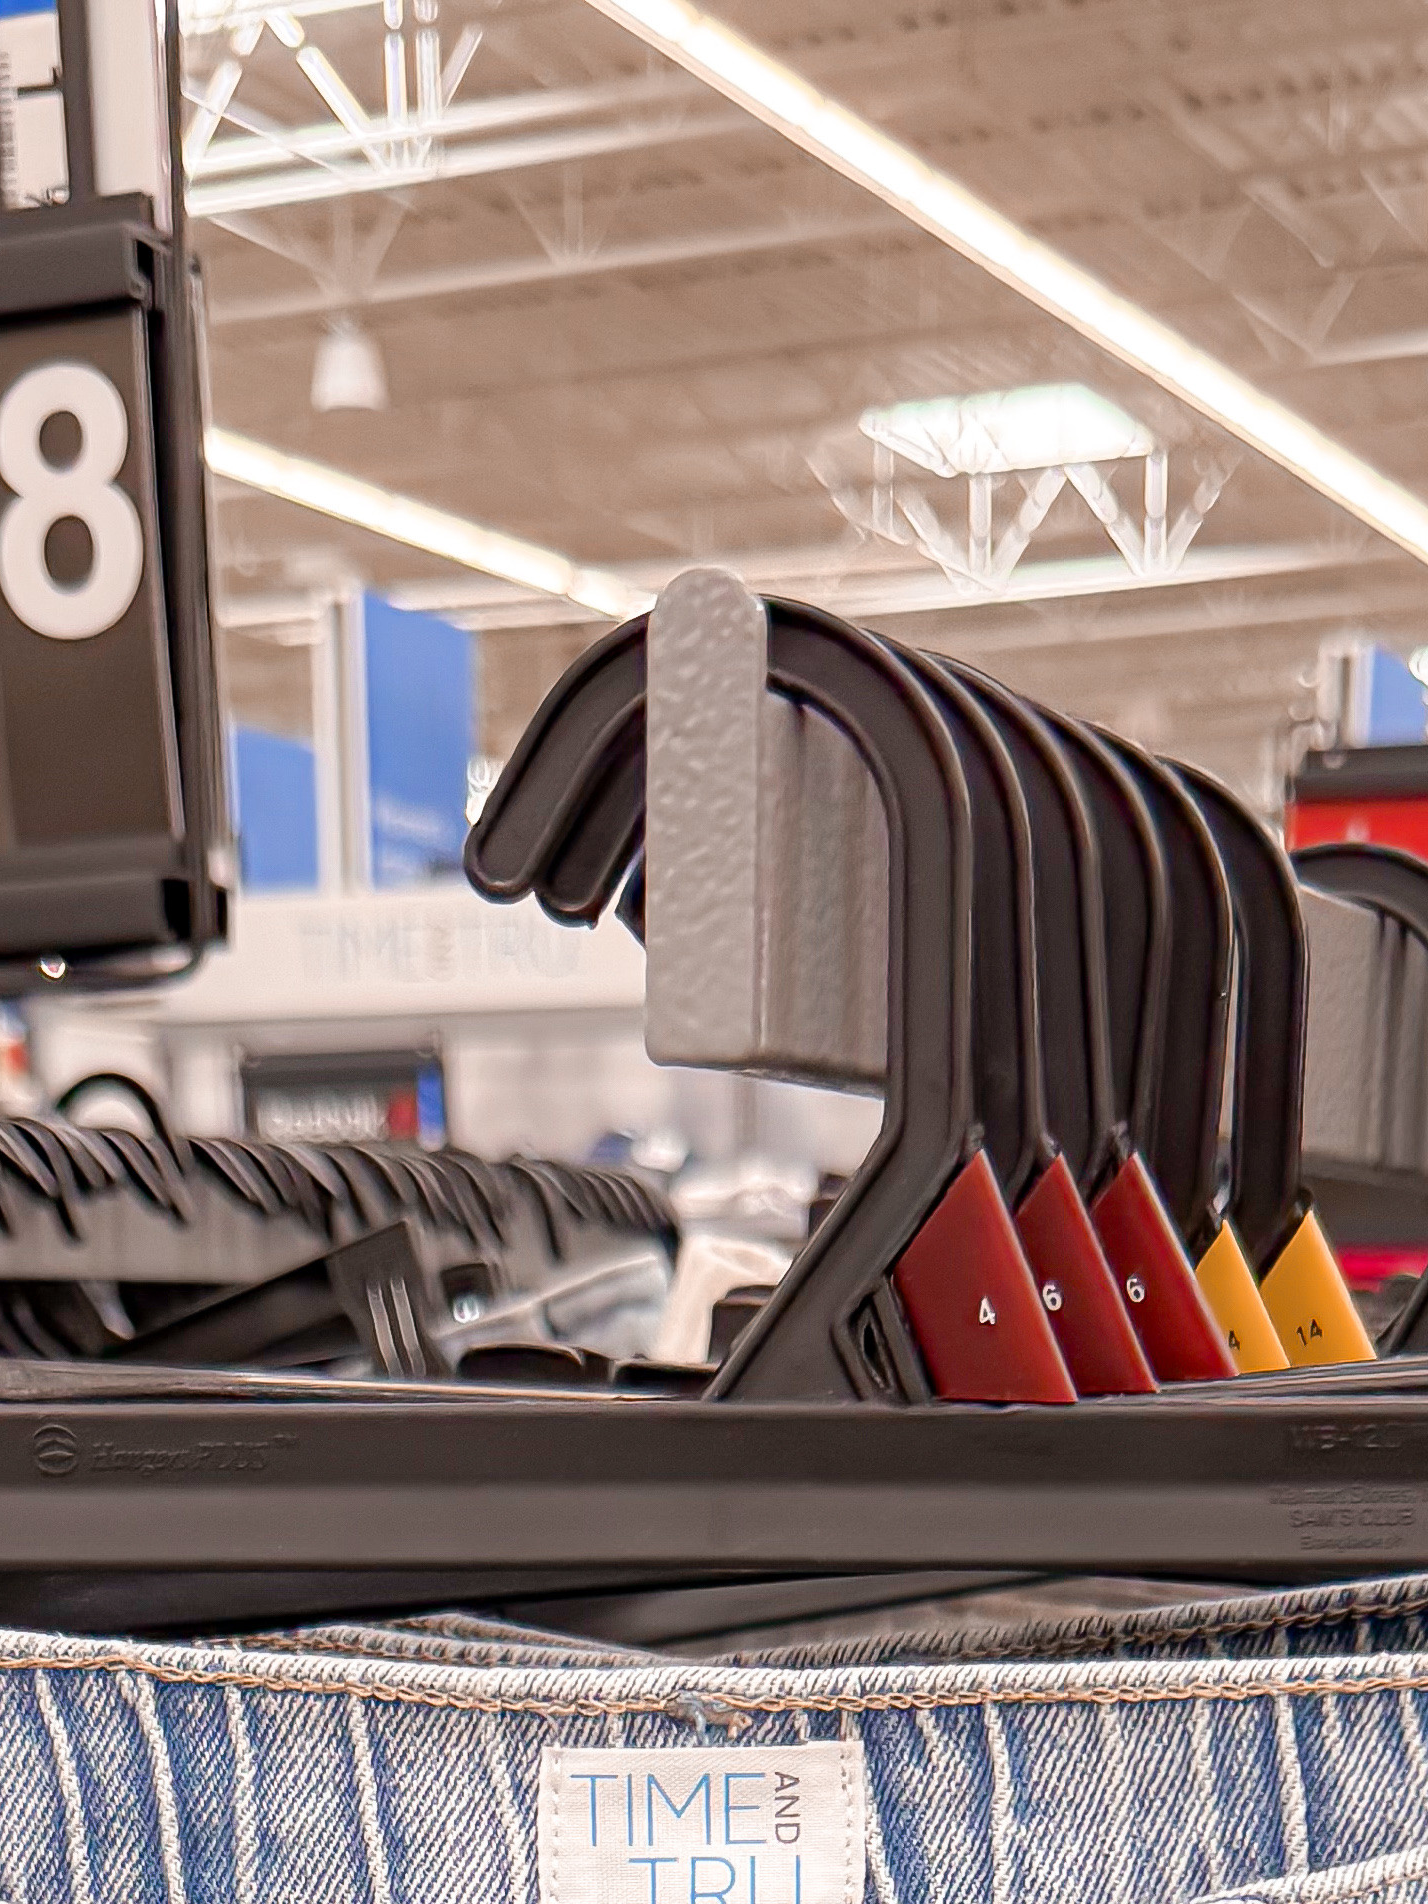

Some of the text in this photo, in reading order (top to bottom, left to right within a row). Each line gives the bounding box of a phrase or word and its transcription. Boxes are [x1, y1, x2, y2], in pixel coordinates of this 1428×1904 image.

[1042, 1284, 1063, 1312] 6
[1125, 1277, 1145, 1304] 6
[978, 1296, 997, 1326] 4
[1228, 1329, 1241, 1351] 4
[1296, 1318, 1323, 1348] 14
[570, 1771, 801, 1848] TIME AND
